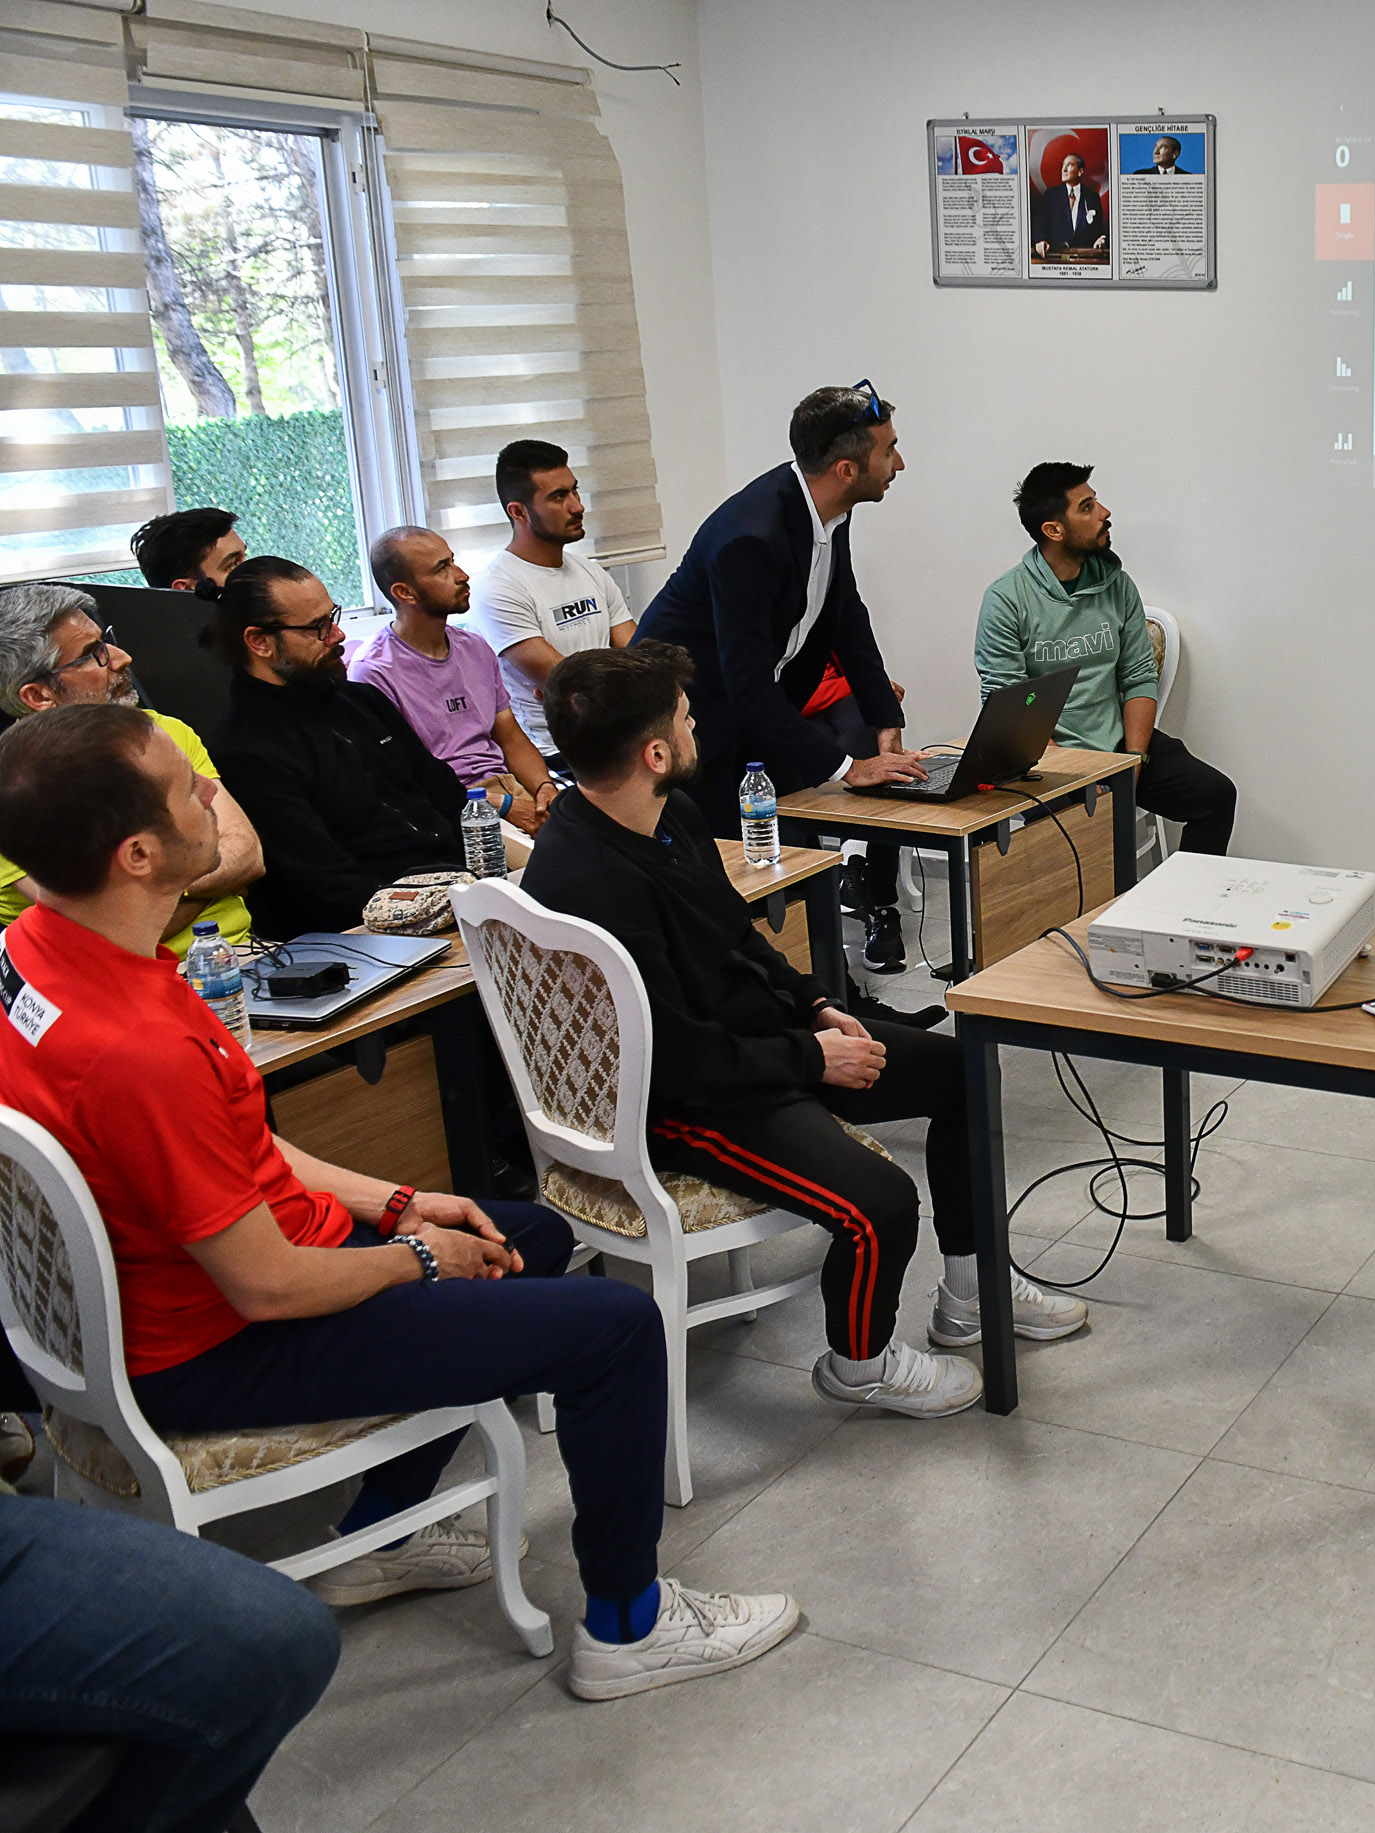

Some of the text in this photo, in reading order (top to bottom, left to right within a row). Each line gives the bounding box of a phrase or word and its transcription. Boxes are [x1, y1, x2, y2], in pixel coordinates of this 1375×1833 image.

[1335, 145, 1350, 168] 0
[561, 597, 598, 620] RUN
[1034, 621, 1115, 662] mavi
[445, 696, 468, 713] LOFT
[1182, 916, 1238, 929] Panasonic
[21, 993, 46, 1020] KONYA
